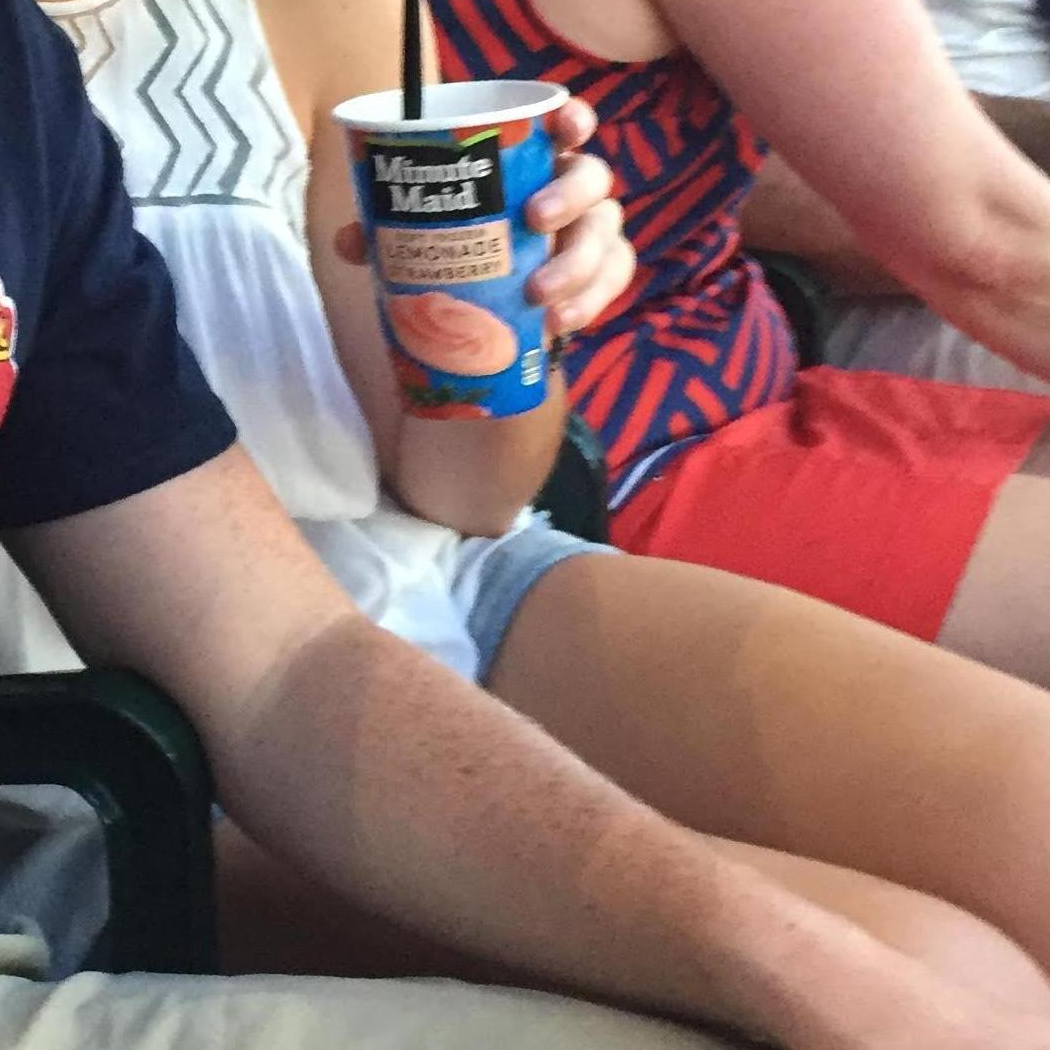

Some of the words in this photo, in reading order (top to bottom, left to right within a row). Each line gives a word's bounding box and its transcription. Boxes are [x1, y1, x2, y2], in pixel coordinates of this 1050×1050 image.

[373, 153, 493, 184] Minute
[388, 181, 481, 213] Maid
[387, 236, 502, 260] LEMONADE
